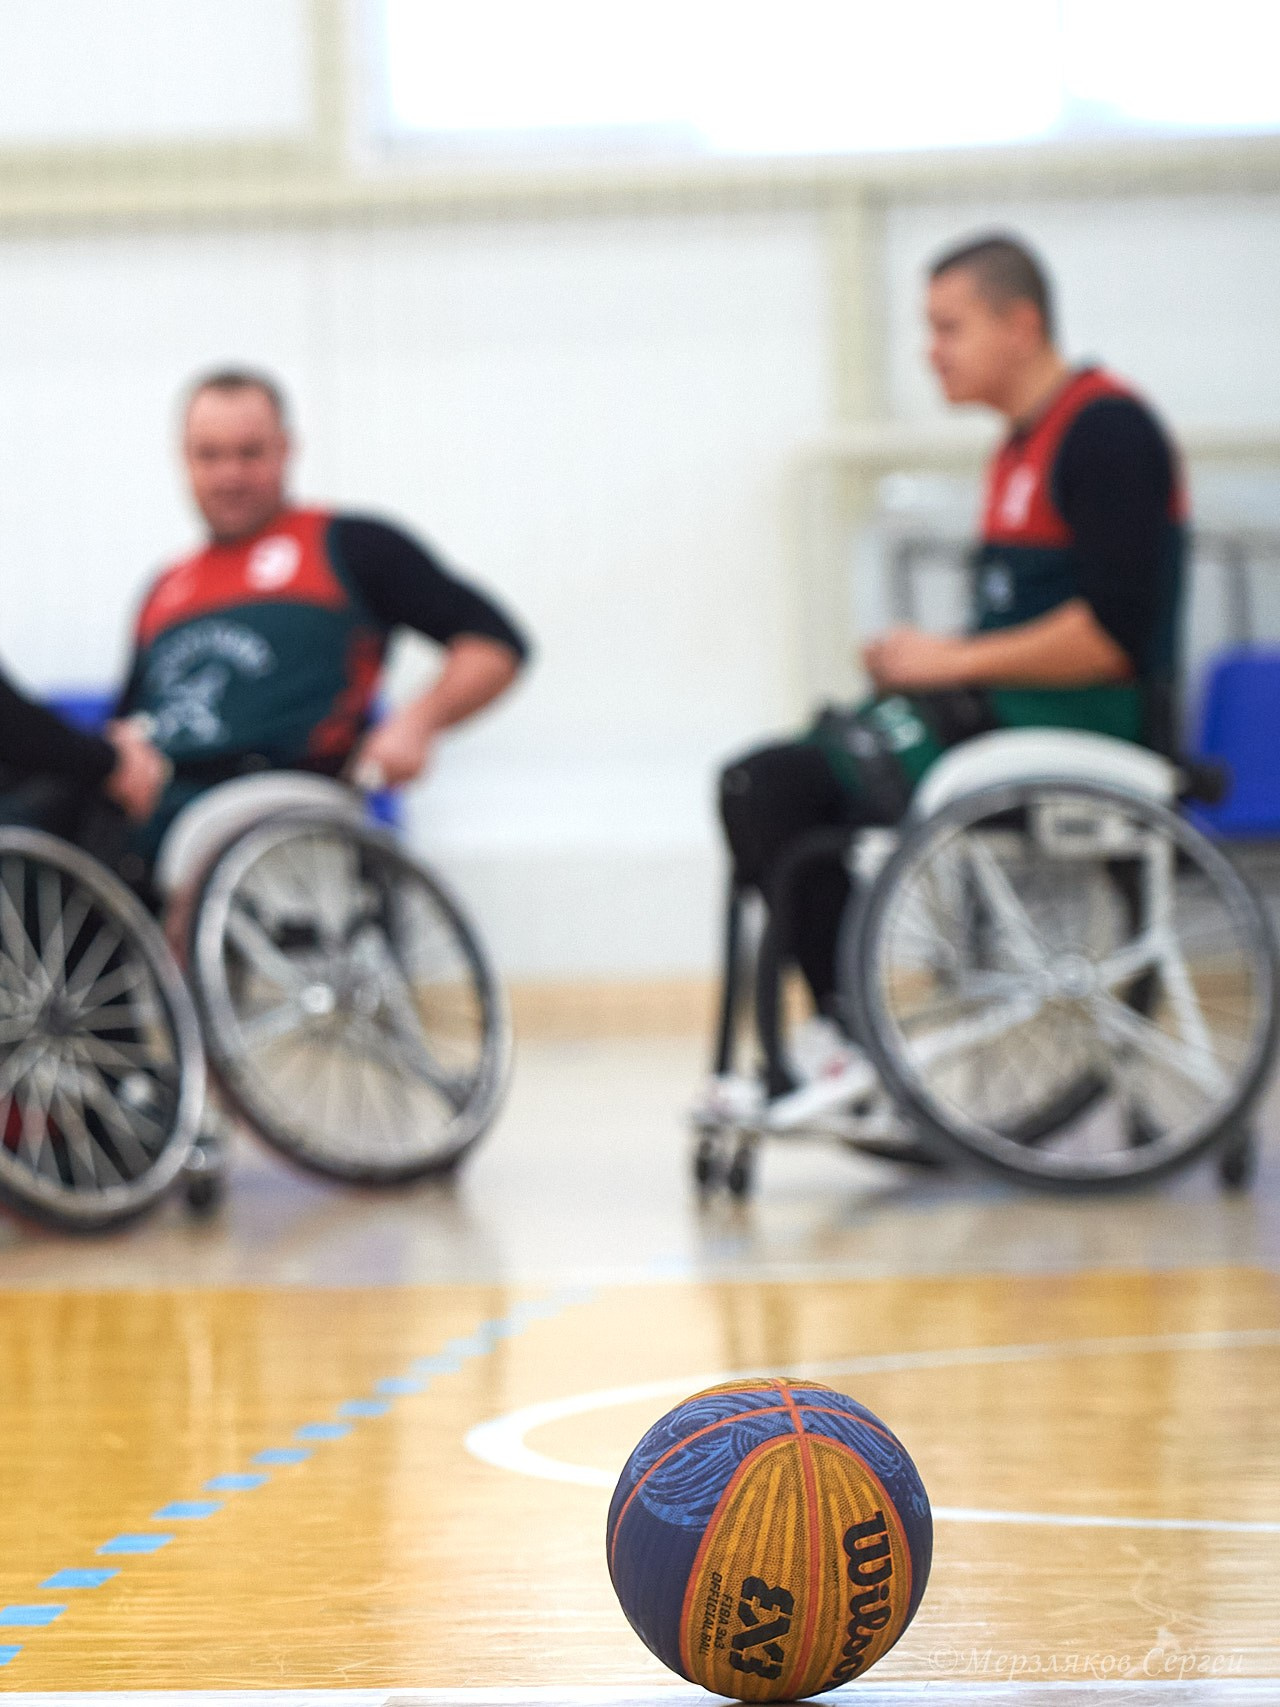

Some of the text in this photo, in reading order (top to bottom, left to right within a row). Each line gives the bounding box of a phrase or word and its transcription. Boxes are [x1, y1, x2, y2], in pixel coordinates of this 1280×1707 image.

[698, 1571, 723, 1656] OFFICIAL BALL
[717, 1594, 732, 1625] FIBA
[821, 1510, 894, 1690] Wilso
